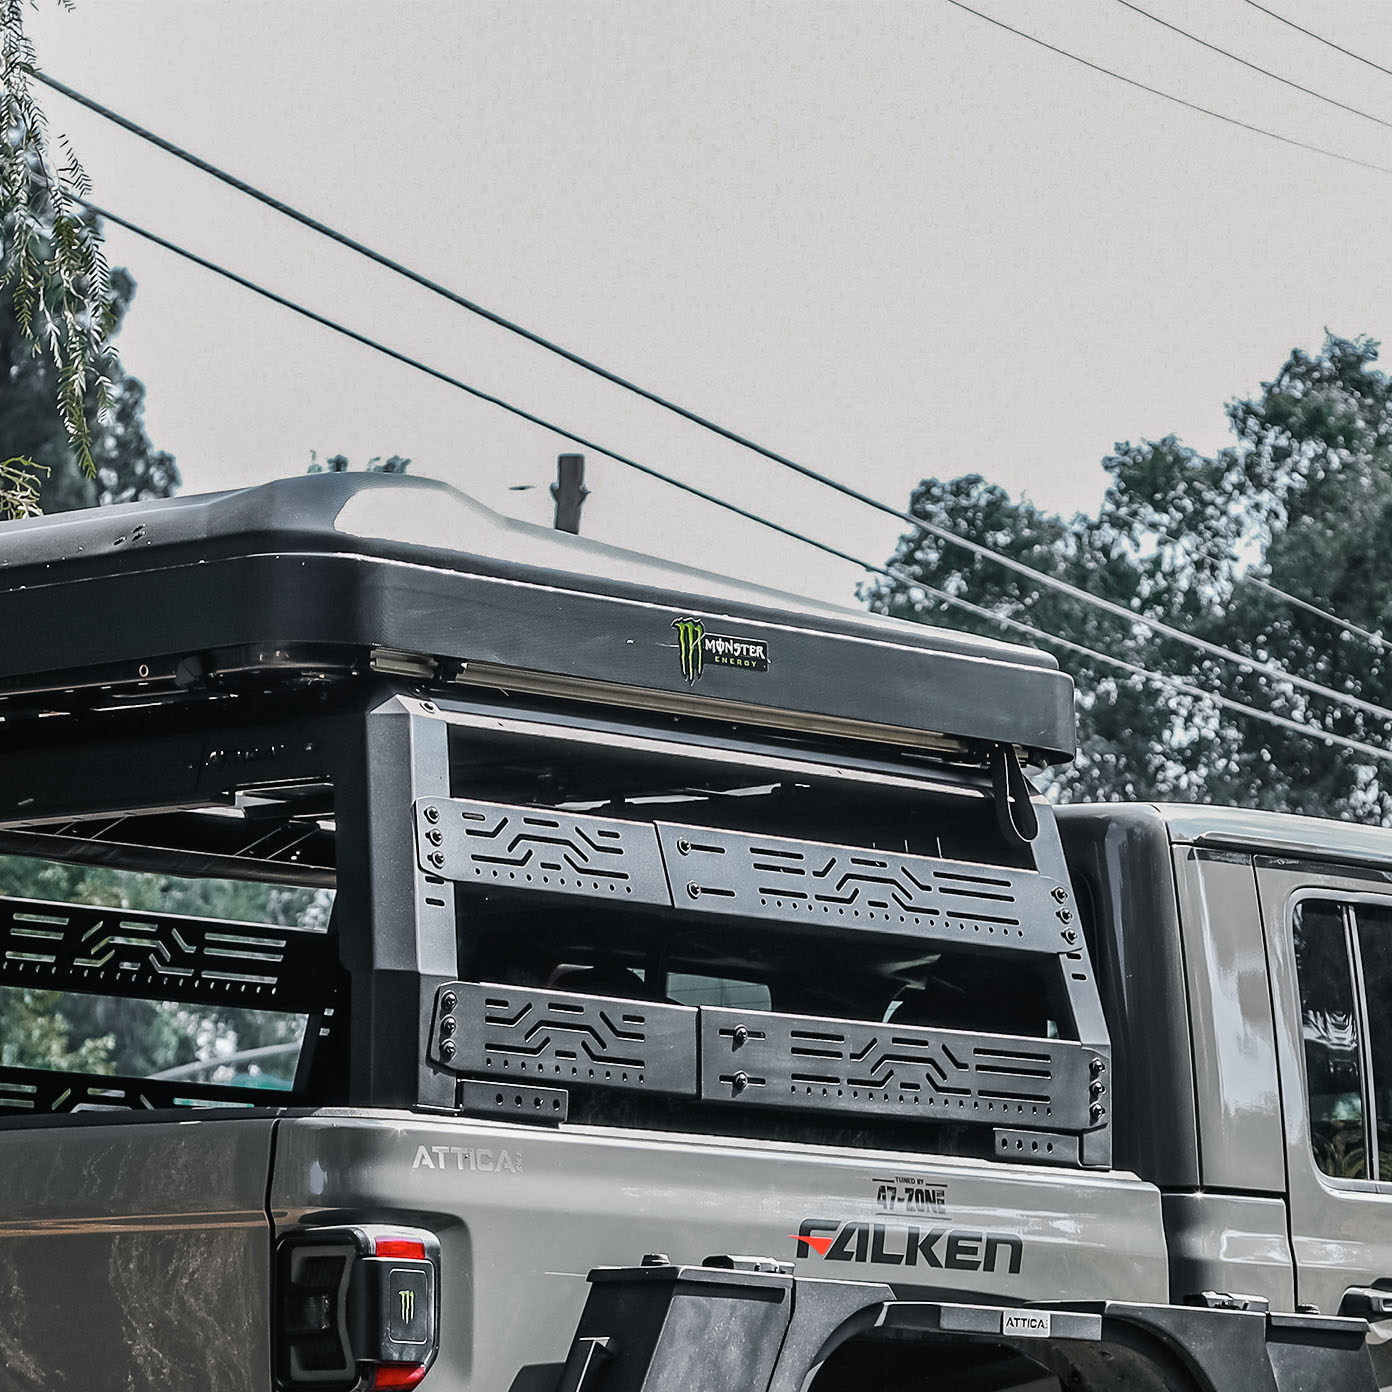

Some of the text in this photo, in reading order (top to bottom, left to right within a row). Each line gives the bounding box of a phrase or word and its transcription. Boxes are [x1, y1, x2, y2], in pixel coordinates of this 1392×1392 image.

[705, 638, 766, 659] MONSTER
[714, 656, 757, 667] ENERGY
[412, 1145, 516, 1173] ATTICA
[877, 1185, 946, 1215] 47-ZONE
[789, 1218, 1023, 1275] FALKEN
[1006, 1317, 1045, 1329] ATTICA
